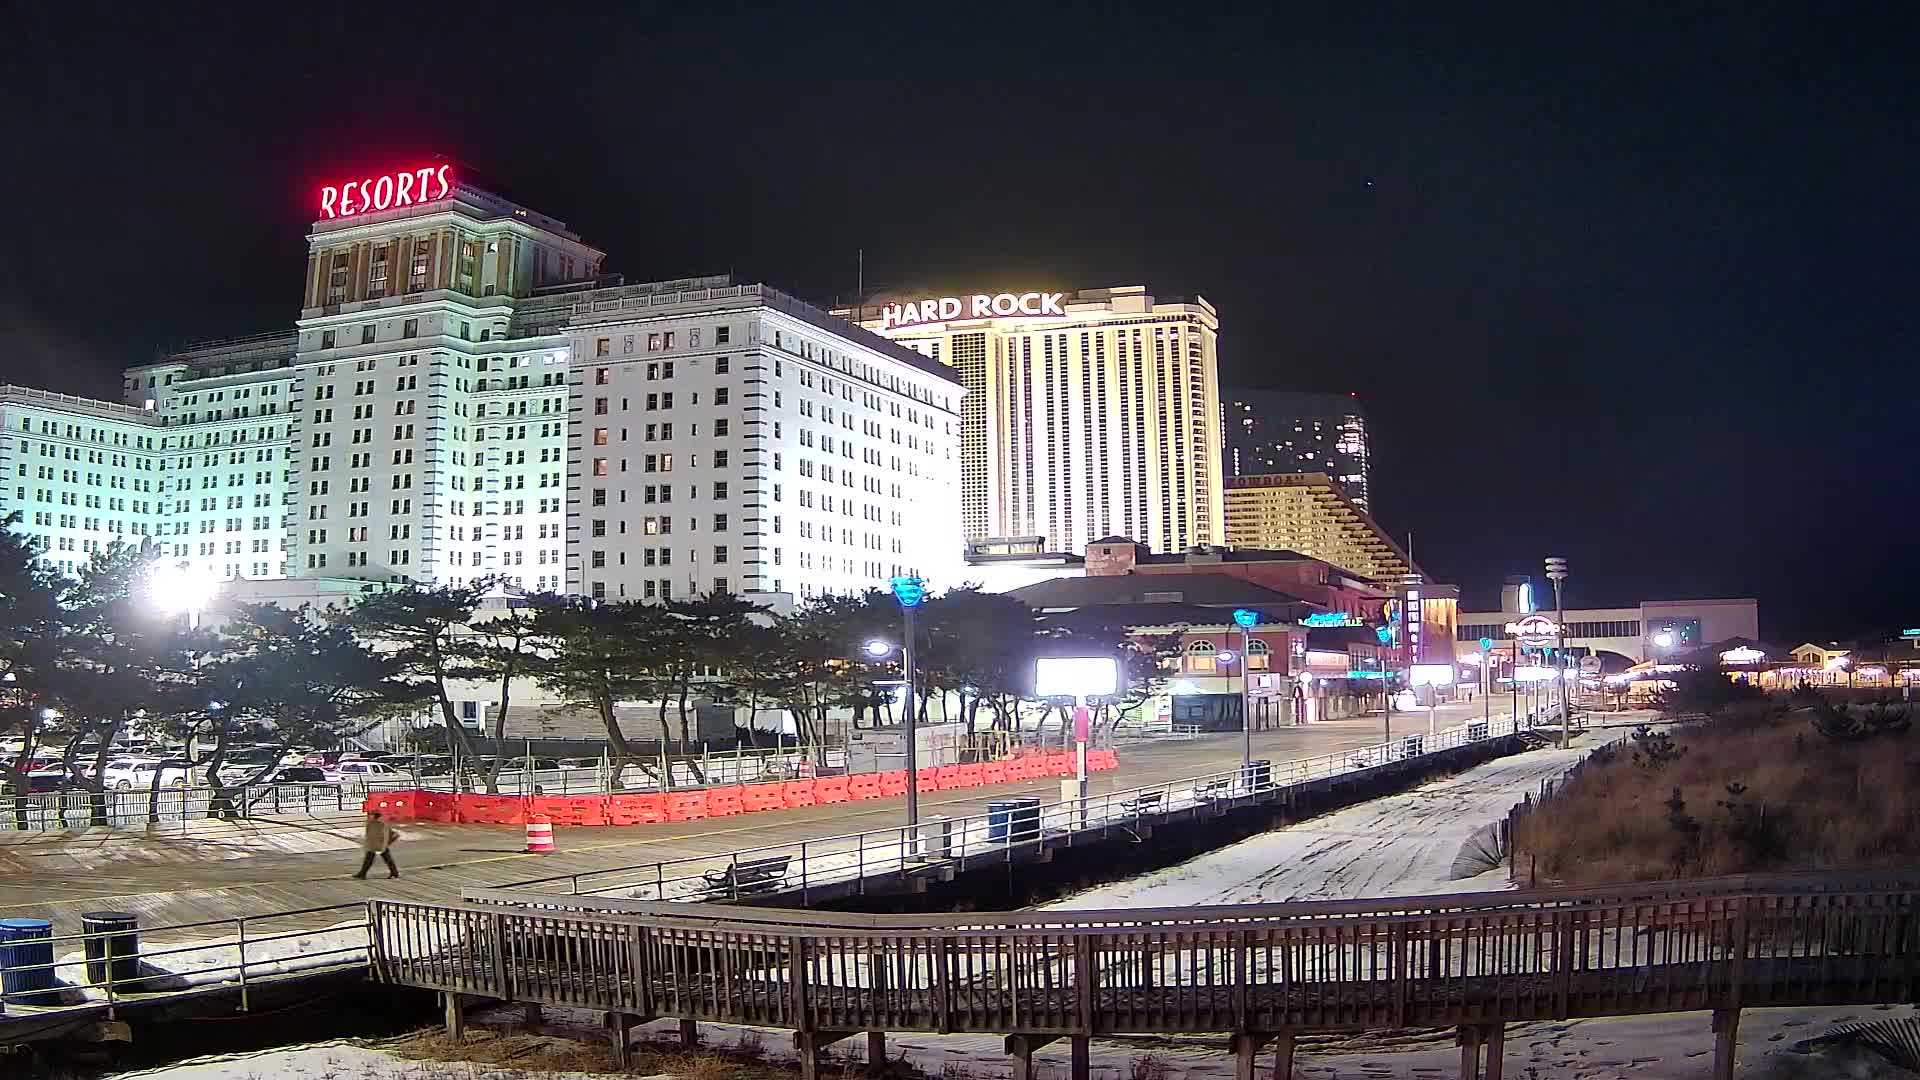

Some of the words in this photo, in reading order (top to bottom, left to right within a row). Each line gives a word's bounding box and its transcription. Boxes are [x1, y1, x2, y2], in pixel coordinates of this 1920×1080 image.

[320, 165, 450, 219] RESORTS
[883, 297, 962, 327] HARD
[971, 292, 1065, 318] ROCK
